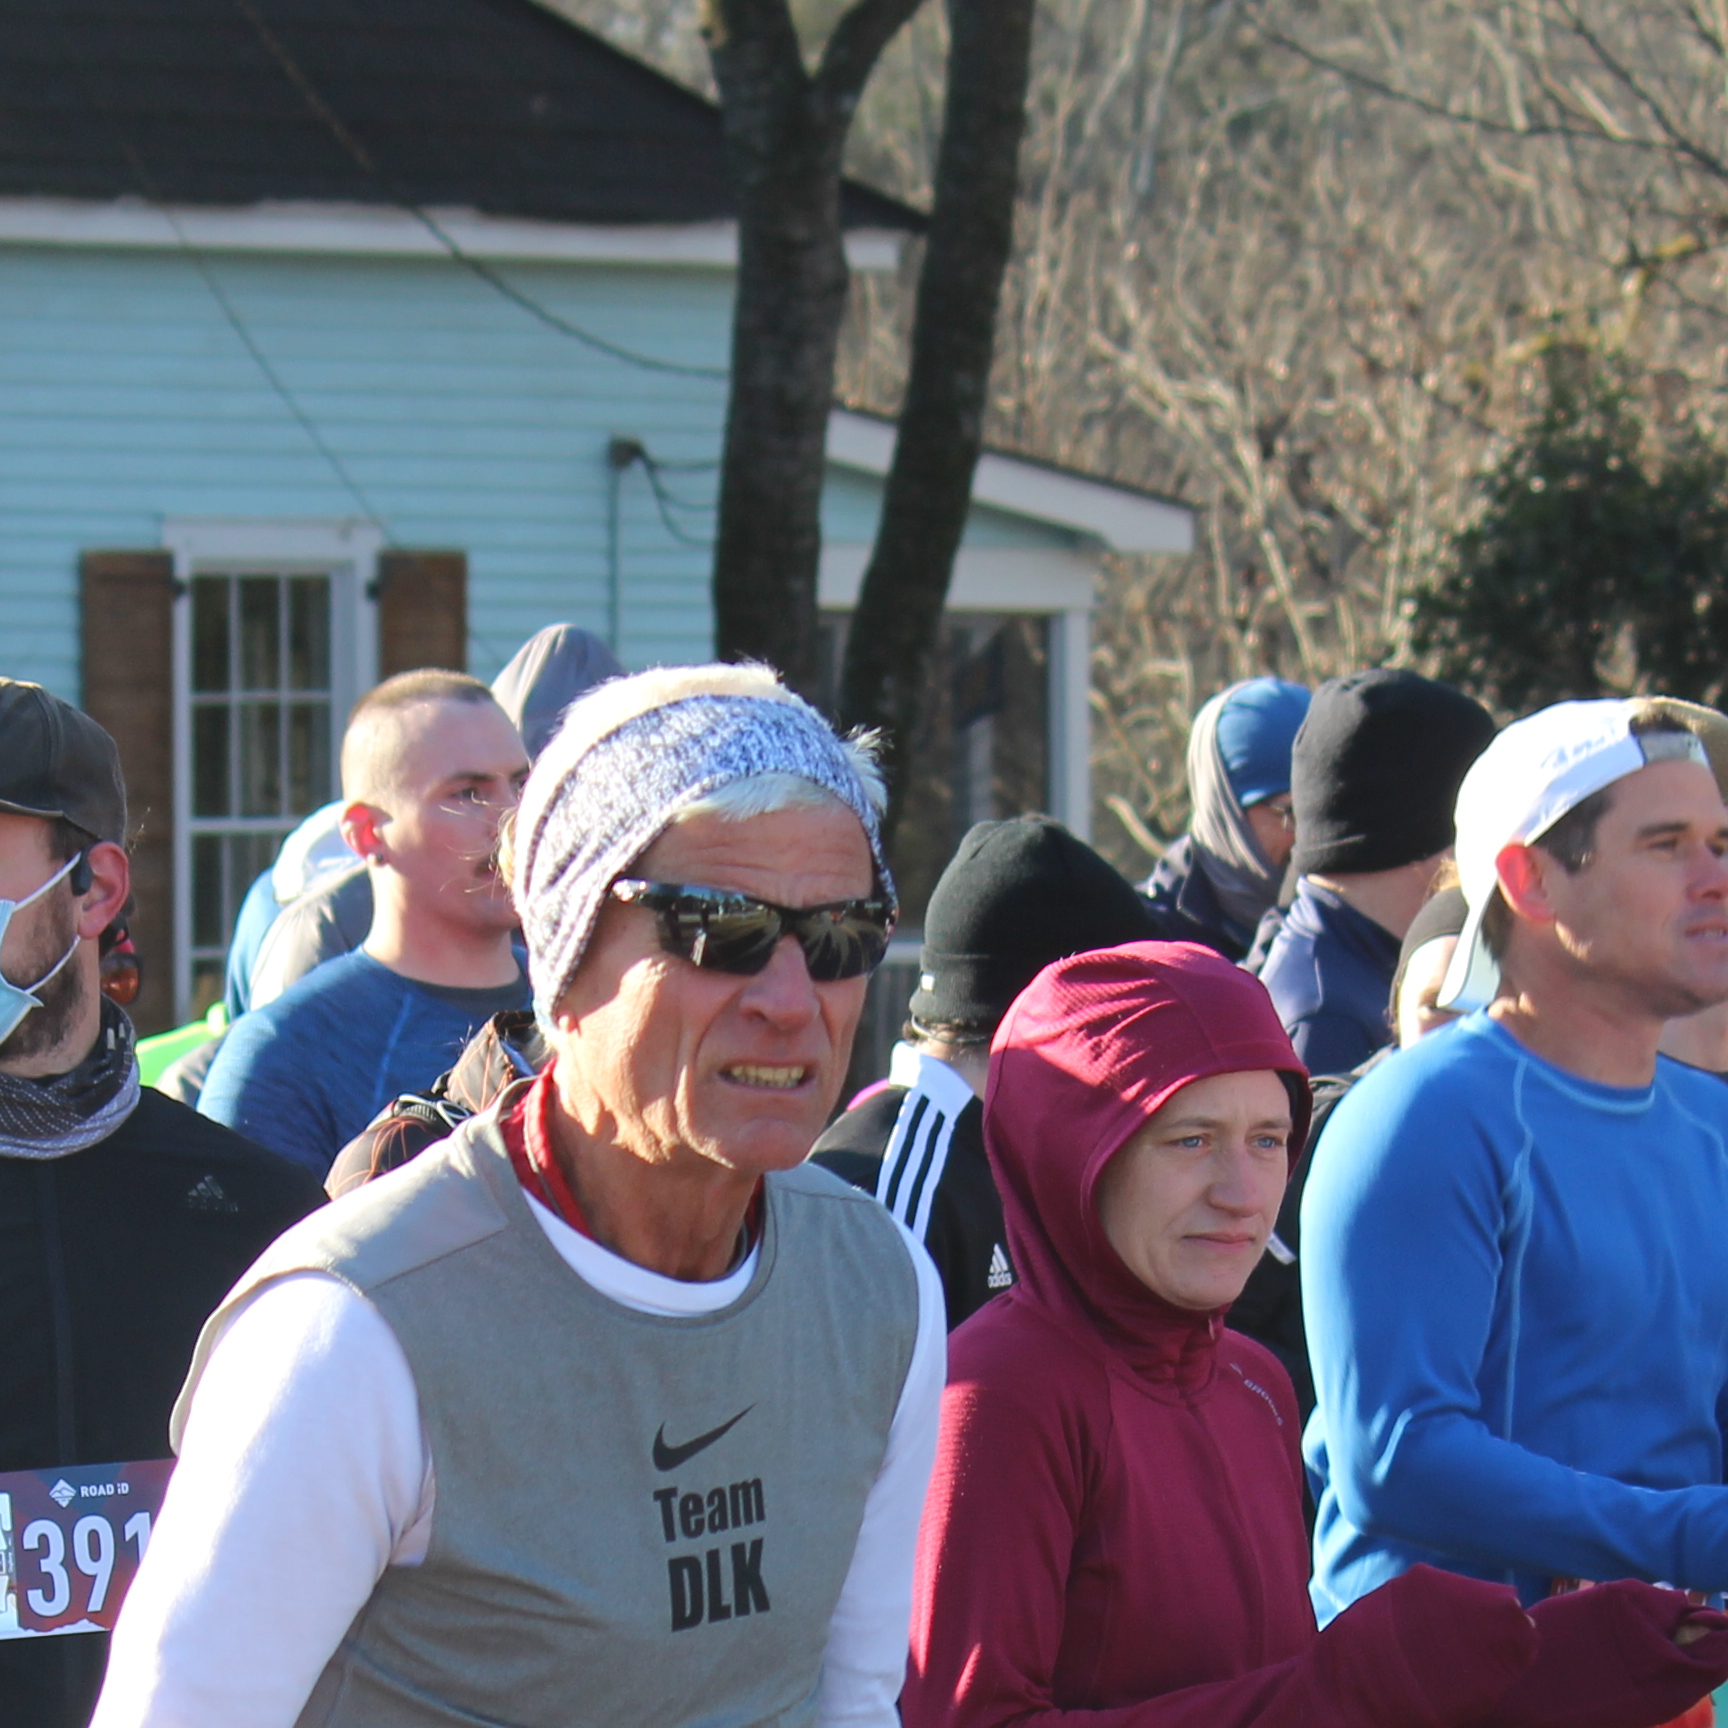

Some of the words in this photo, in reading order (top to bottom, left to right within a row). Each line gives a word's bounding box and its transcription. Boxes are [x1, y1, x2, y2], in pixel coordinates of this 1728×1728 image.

[80, 1483, 115, 1498] ROAD
[653, 1476, 766, 1543] Team
[667, 1537, 771, 1633] DLK
